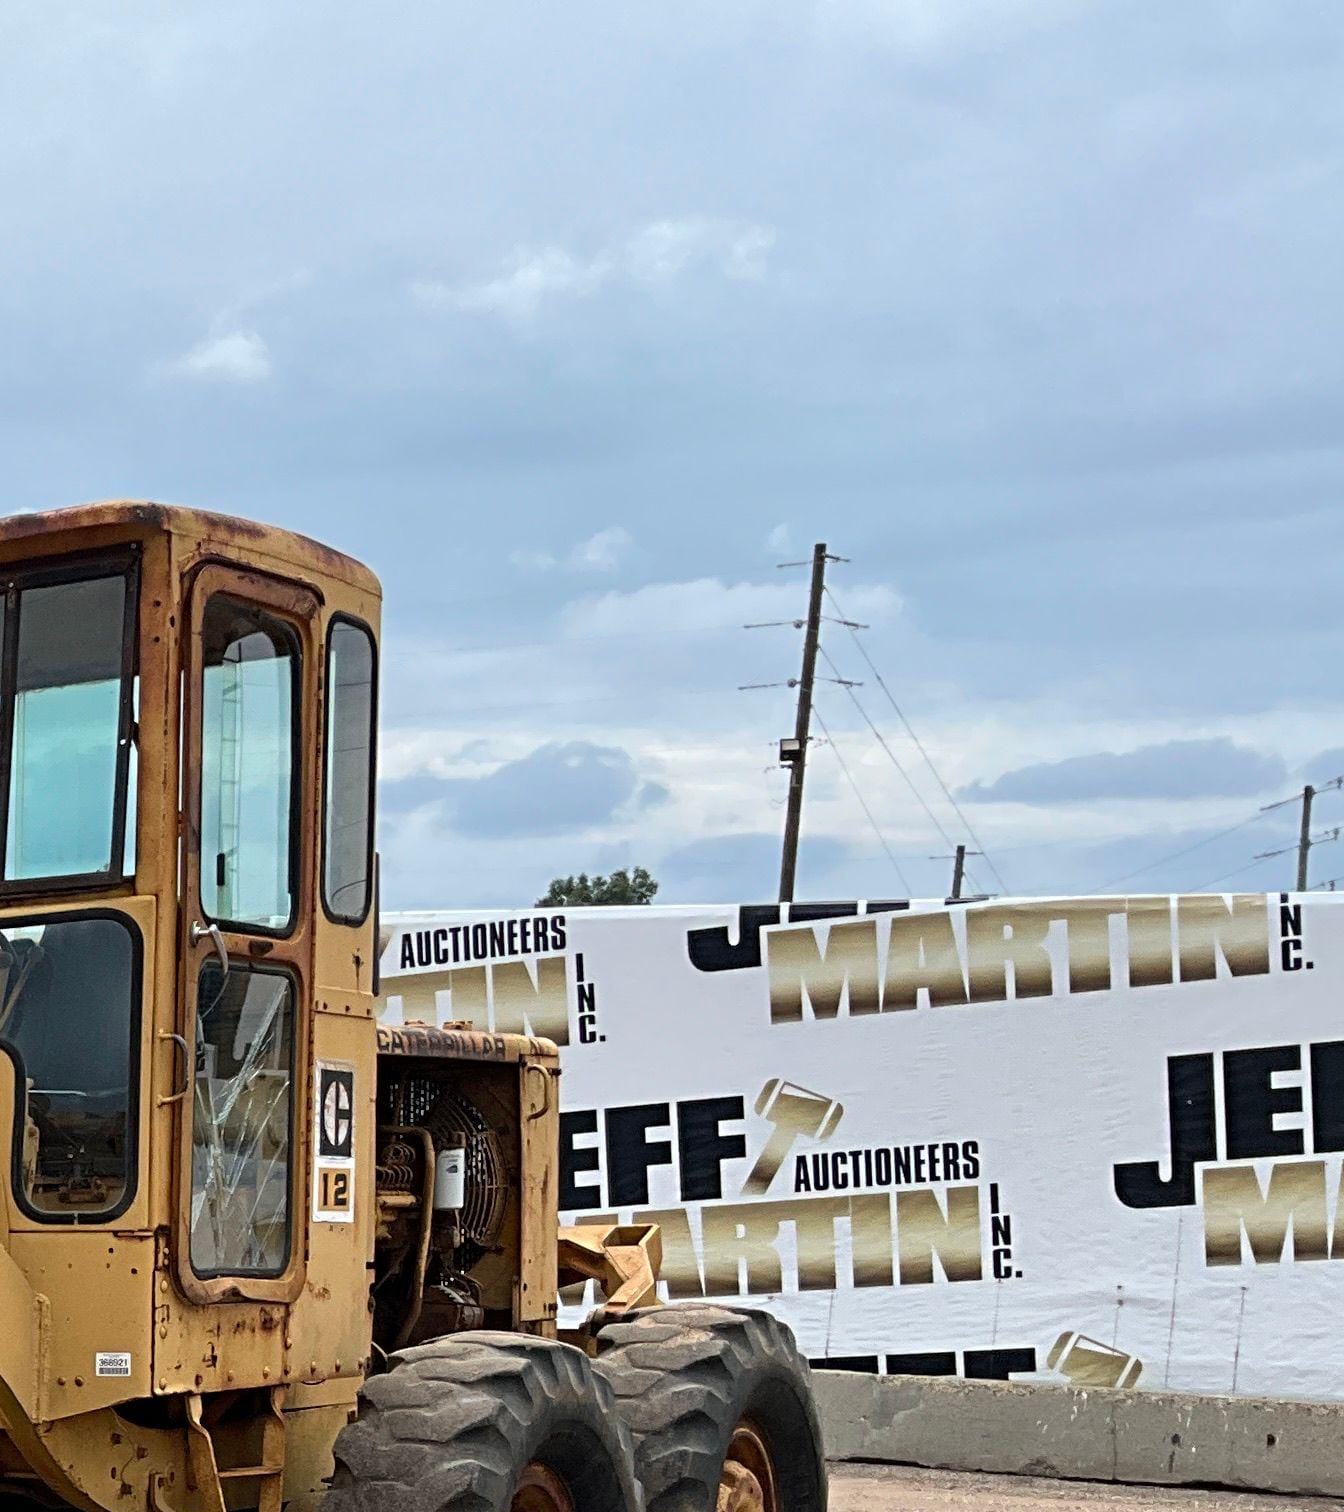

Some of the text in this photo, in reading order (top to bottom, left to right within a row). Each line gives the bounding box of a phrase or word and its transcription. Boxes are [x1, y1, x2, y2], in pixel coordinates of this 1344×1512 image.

[400, 915, 566, 969] AUCTIONEERS
[767, 894, 1270, 1025] MARTIN
[559, 1096, 746, 1211] EFF
[794, 1140, 980, 1193] AUCTIONEERS
[321, 1173, 348, 1207] 12
